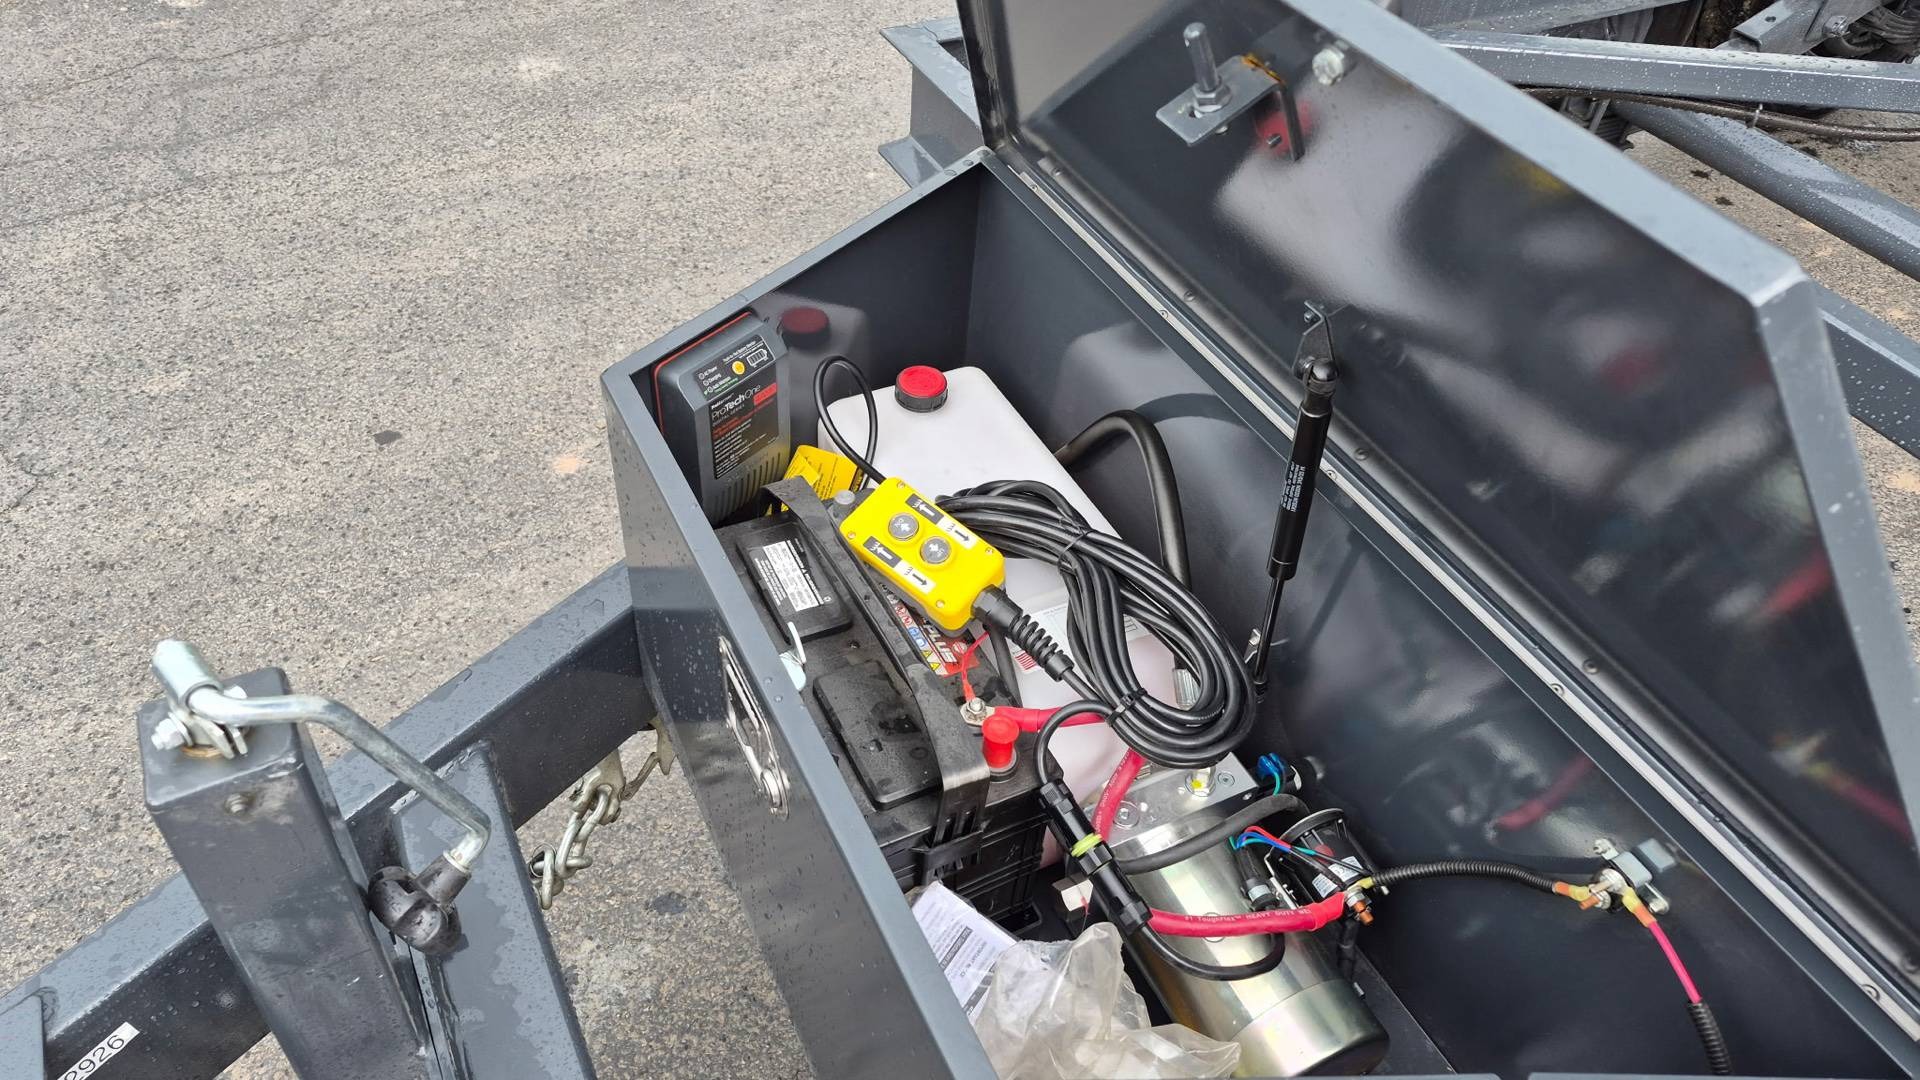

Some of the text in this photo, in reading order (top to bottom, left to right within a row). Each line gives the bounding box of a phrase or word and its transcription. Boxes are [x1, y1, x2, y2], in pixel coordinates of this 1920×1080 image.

[711, 385, 761, 419] ProTechOne
[923, 624, 958, 663] PLUS
[1245, 912, 1271, 920] HEAVY
[1275, 909, 1296, 917] DUTY
